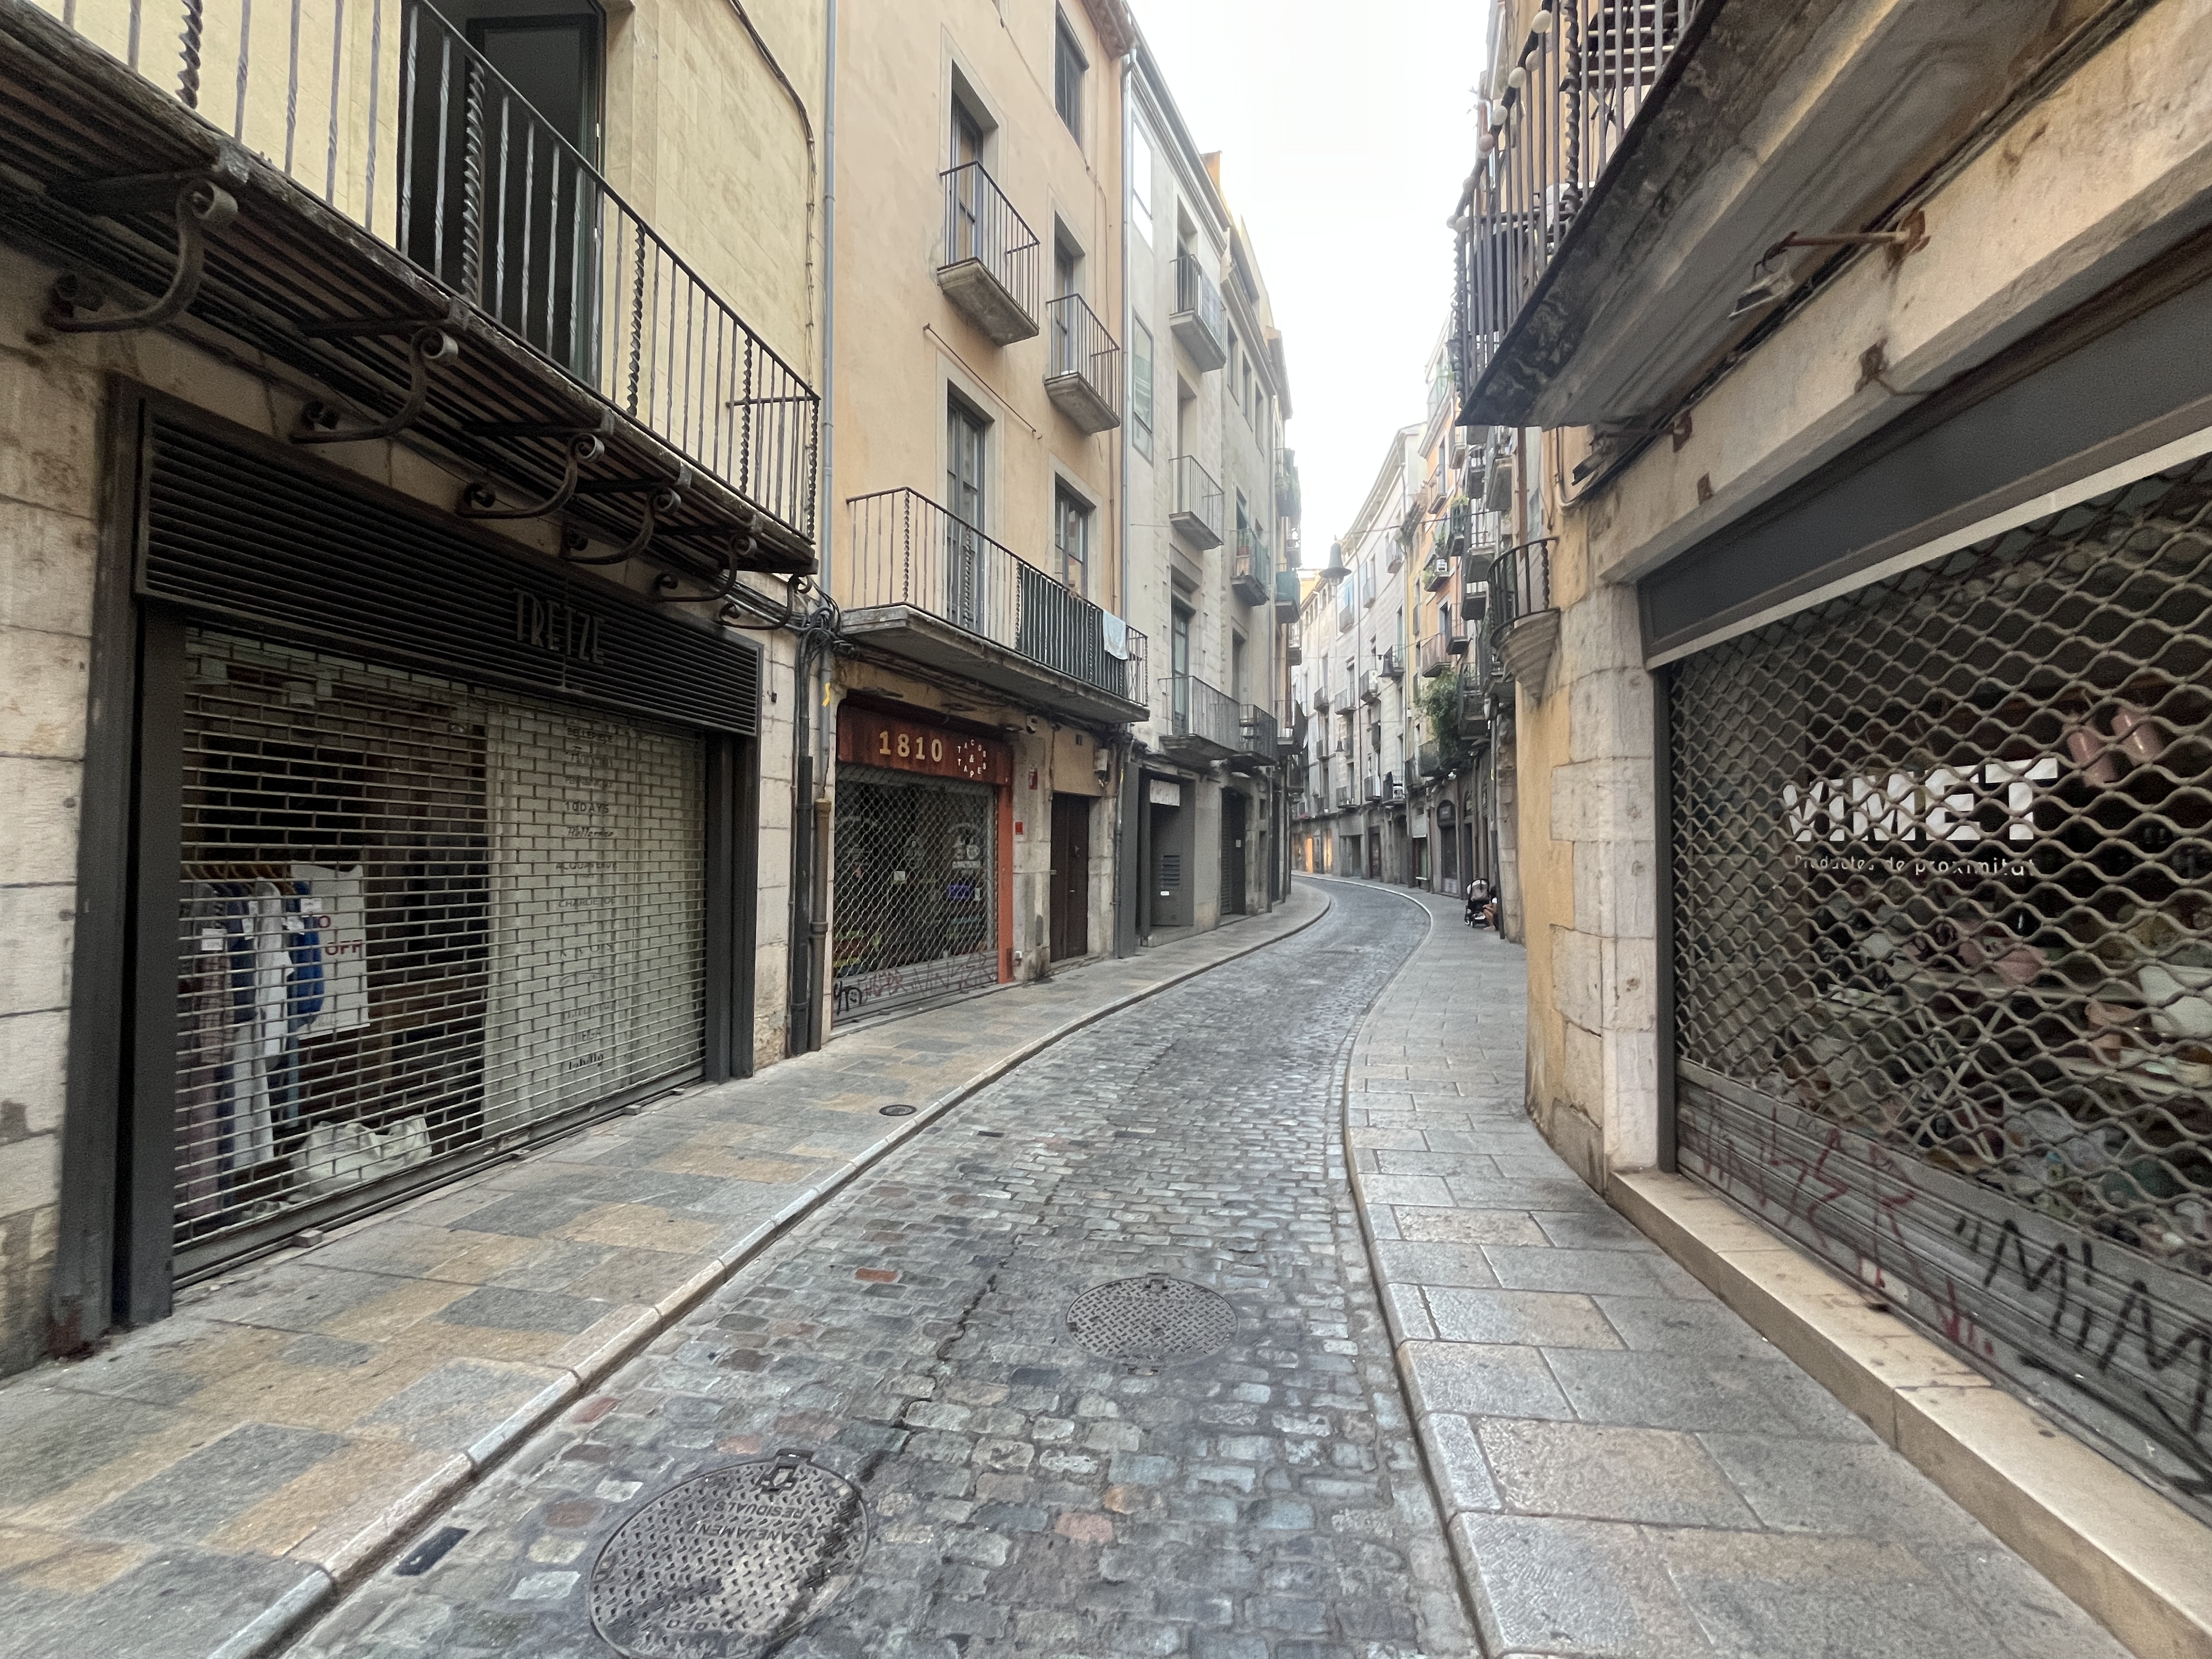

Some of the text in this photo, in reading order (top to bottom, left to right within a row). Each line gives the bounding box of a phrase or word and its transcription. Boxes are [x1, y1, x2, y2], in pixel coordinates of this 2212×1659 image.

[879, 730, 943, 762] 1810
[969, 754, 974, 763] &
[1886, 856, 1905, 871] de
[713, 1500, 806, 1519] RESIDUALS
